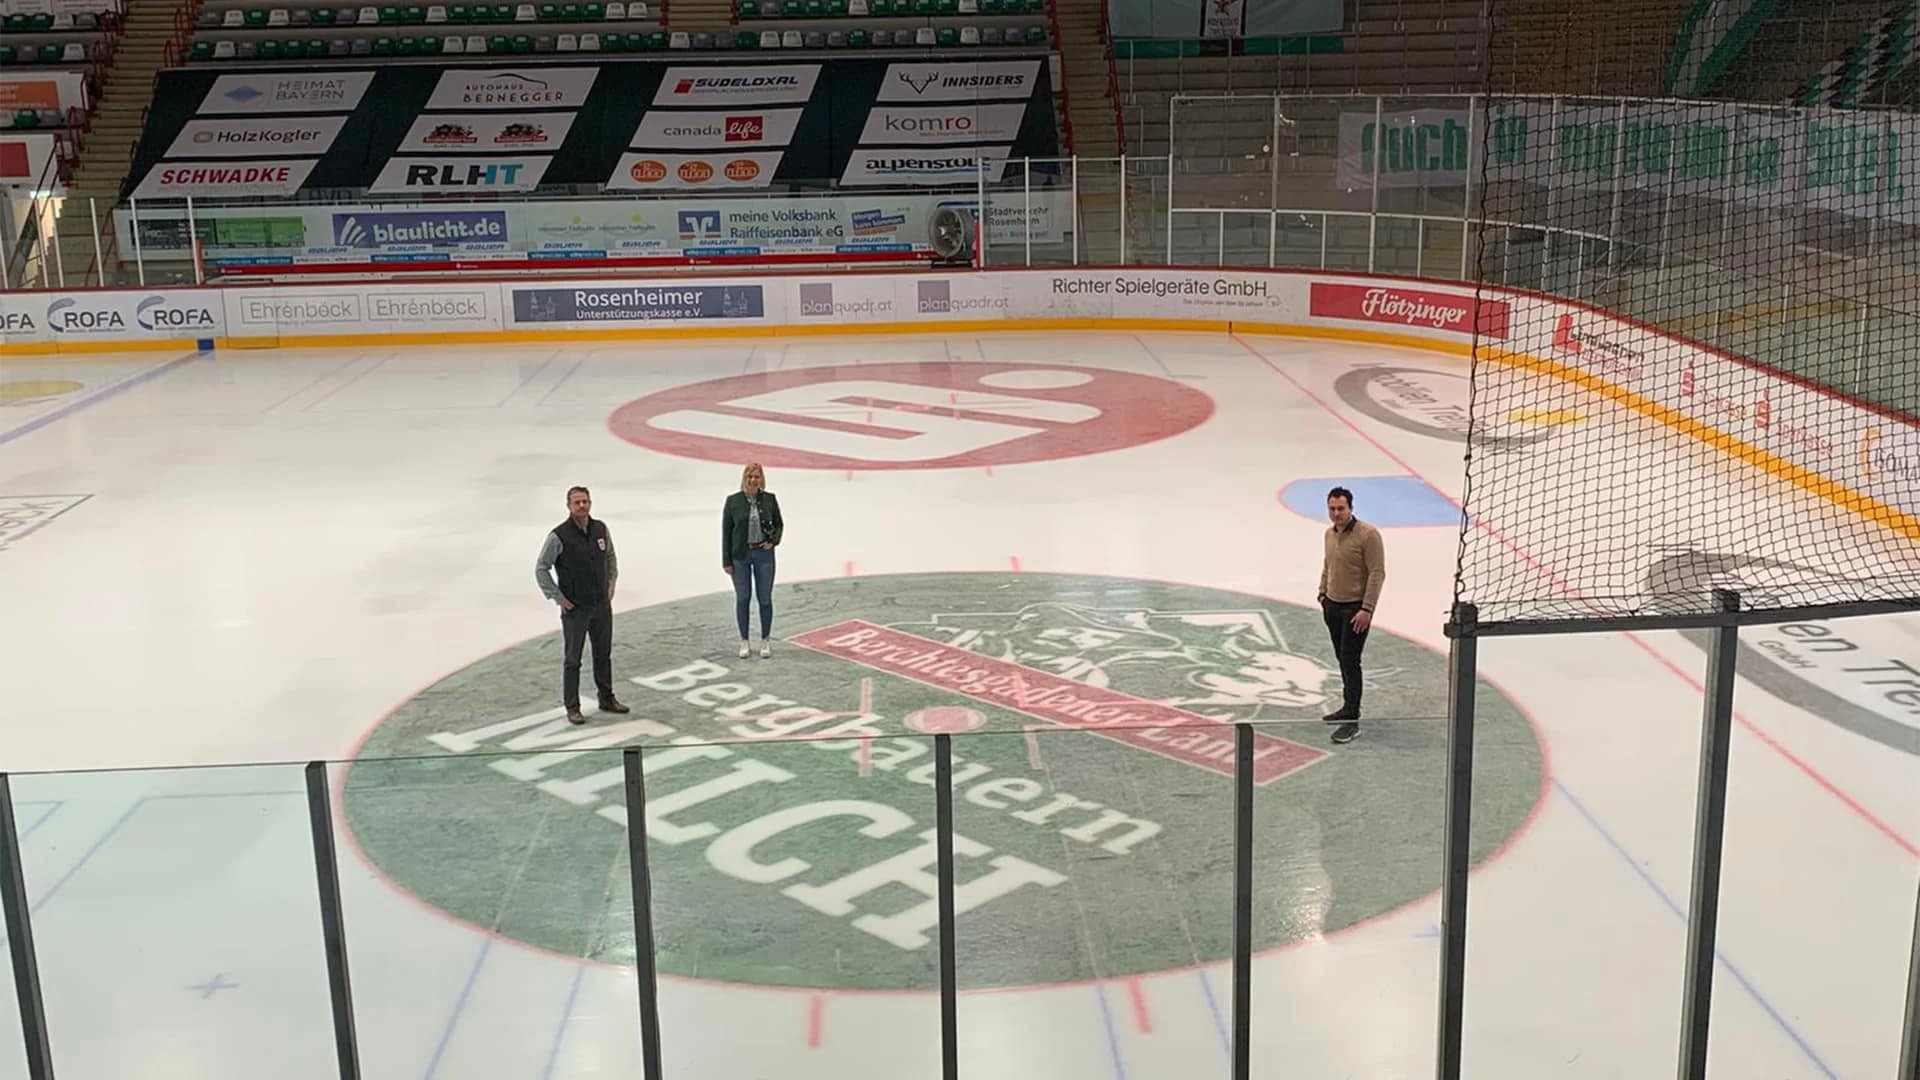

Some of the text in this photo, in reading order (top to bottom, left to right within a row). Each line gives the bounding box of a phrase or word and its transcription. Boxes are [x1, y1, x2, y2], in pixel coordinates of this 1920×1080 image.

[277, 80, 345, 90] HEIMAT
[942, 74, 1024, 87] INNSIDERS
[275, 90, 345, 100] BAYERN
[463, 91, 564, 103] BERNEGGER
[663, 117, 762, 139] canada life
[885, 114, 971, 131] komro
[216, 129, 321, 143] HolzKogler
[160, 167, 290, 185] SCHWADKE
[406, 164, 525, 186] RLHT
[729, 208, 837, 223] meine Volksbank
[373, 217, 501, 243] blaulicht.de
[730, 225, 822, 239] Raiffeisenbank
[825, 225, 844, 237] eG
[1052, 277, 1268, 297] Richter Spielgeräte GmbH
[575, 288, 703, 307] Rosenheimer
[1361, 288, 1467, 325] Flötzinger
[64, 311, 125, 328] ROFA
[154, 308, 215, 326] ROFA
[576, 307, 703, 320] Unterstützungskasse e.V.
[824, 627, 1144, 726] Berchtesgadener
[629, 657, 1164, 856] Bergbauern
[424, 695, 1069, 952] MILCH
